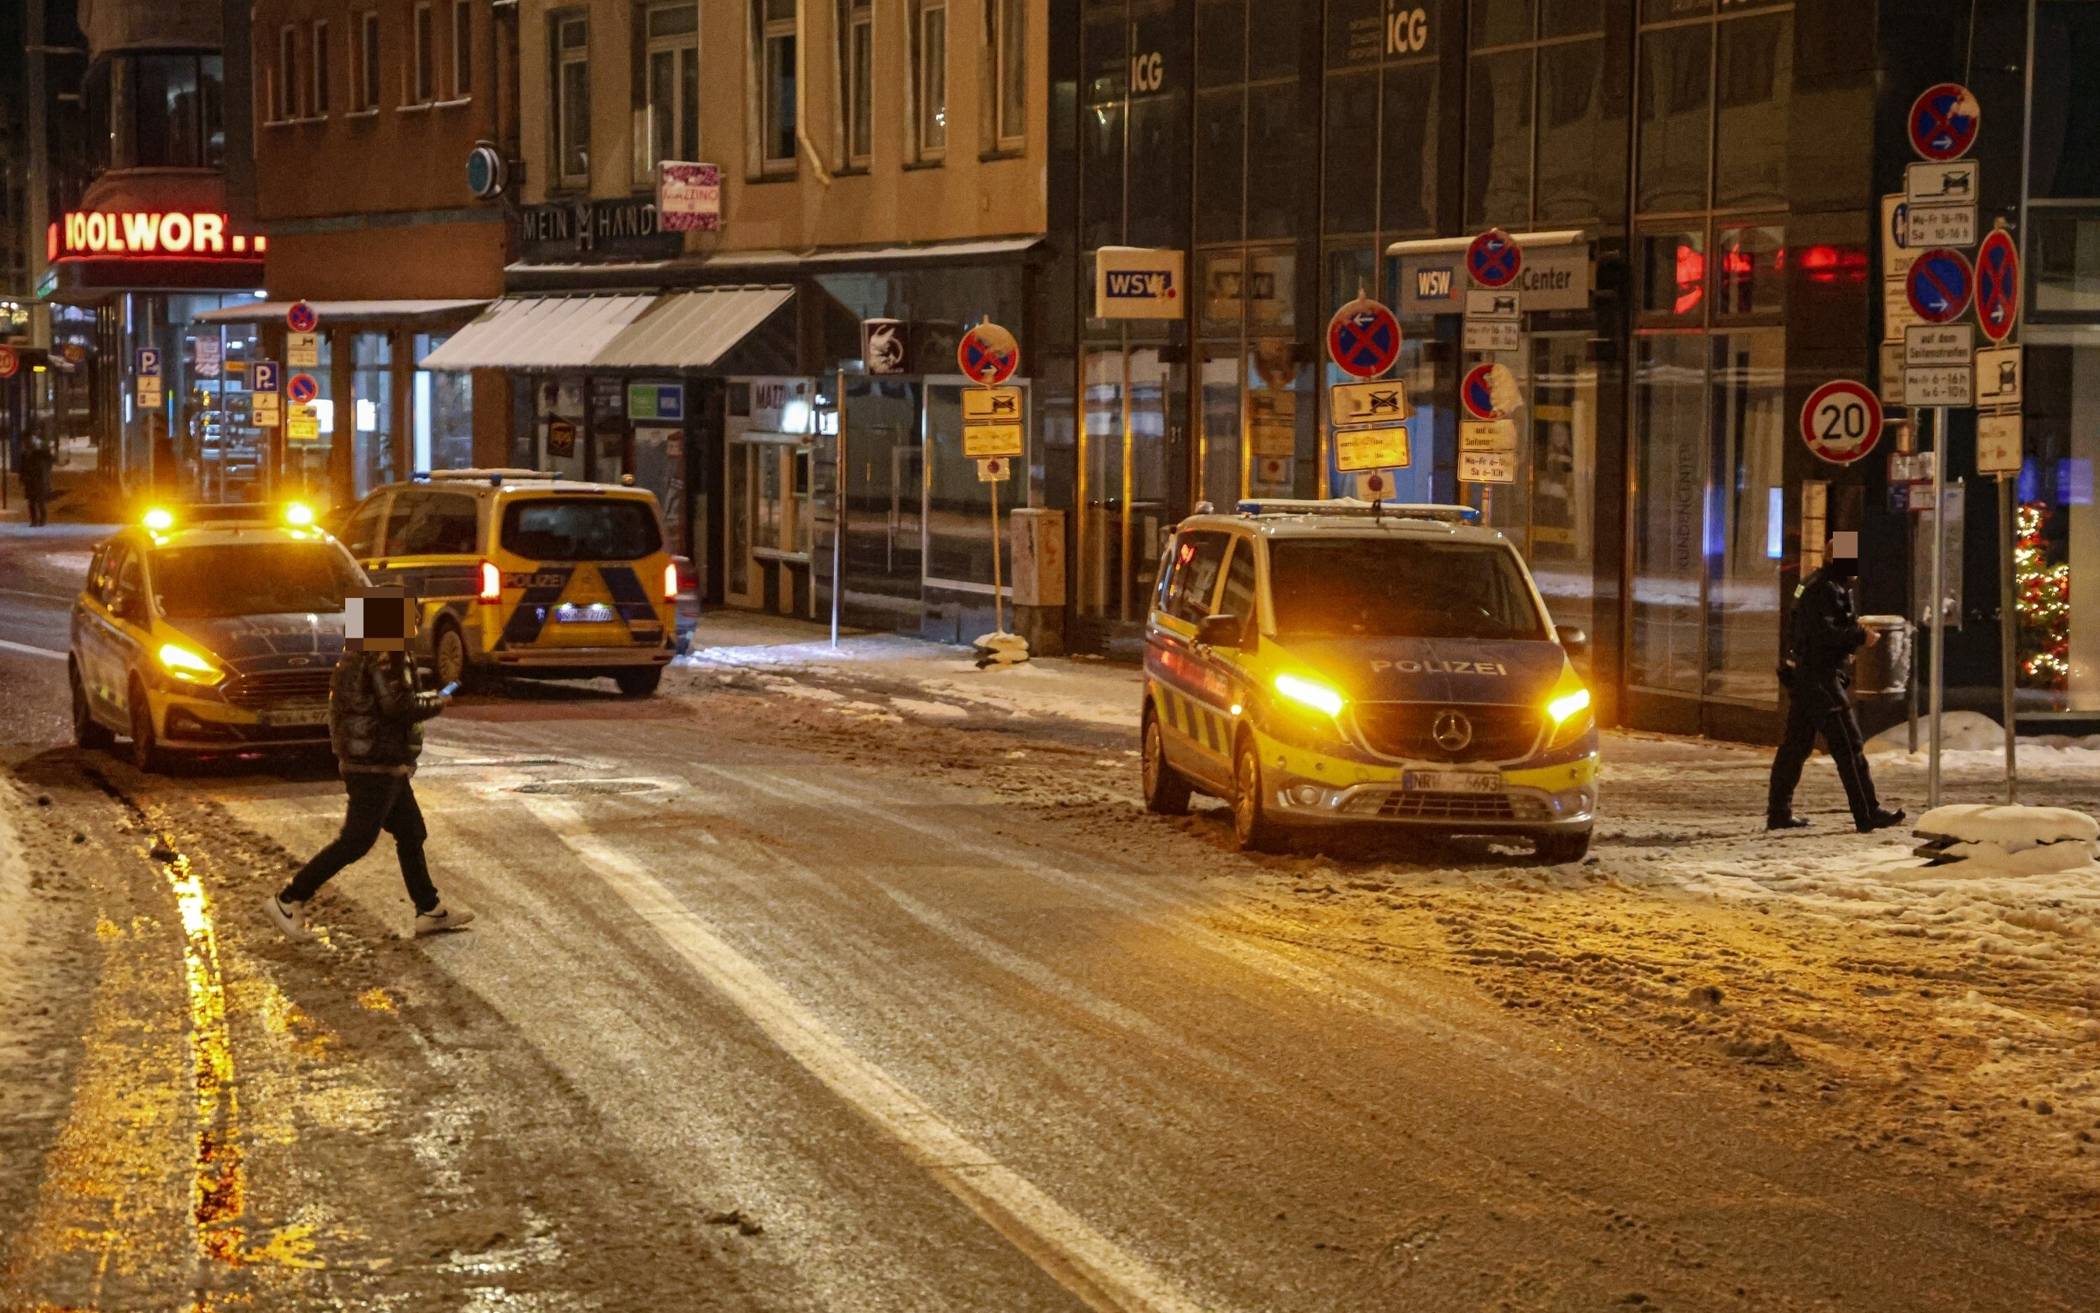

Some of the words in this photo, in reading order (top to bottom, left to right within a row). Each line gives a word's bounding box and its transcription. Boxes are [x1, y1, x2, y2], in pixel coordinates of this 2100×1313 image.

[1387, 8, 1428, 55] ICG
[1131, 52, 1164, 92] ICG
[523, 209, 567, 241] MEIN
[1417, 271, 1451, 296] WSW
[255, 365, 272, 389] P
[1821, 402, 1864, 440] 20
[1369, 659, 1507, 677] POLIZEI
